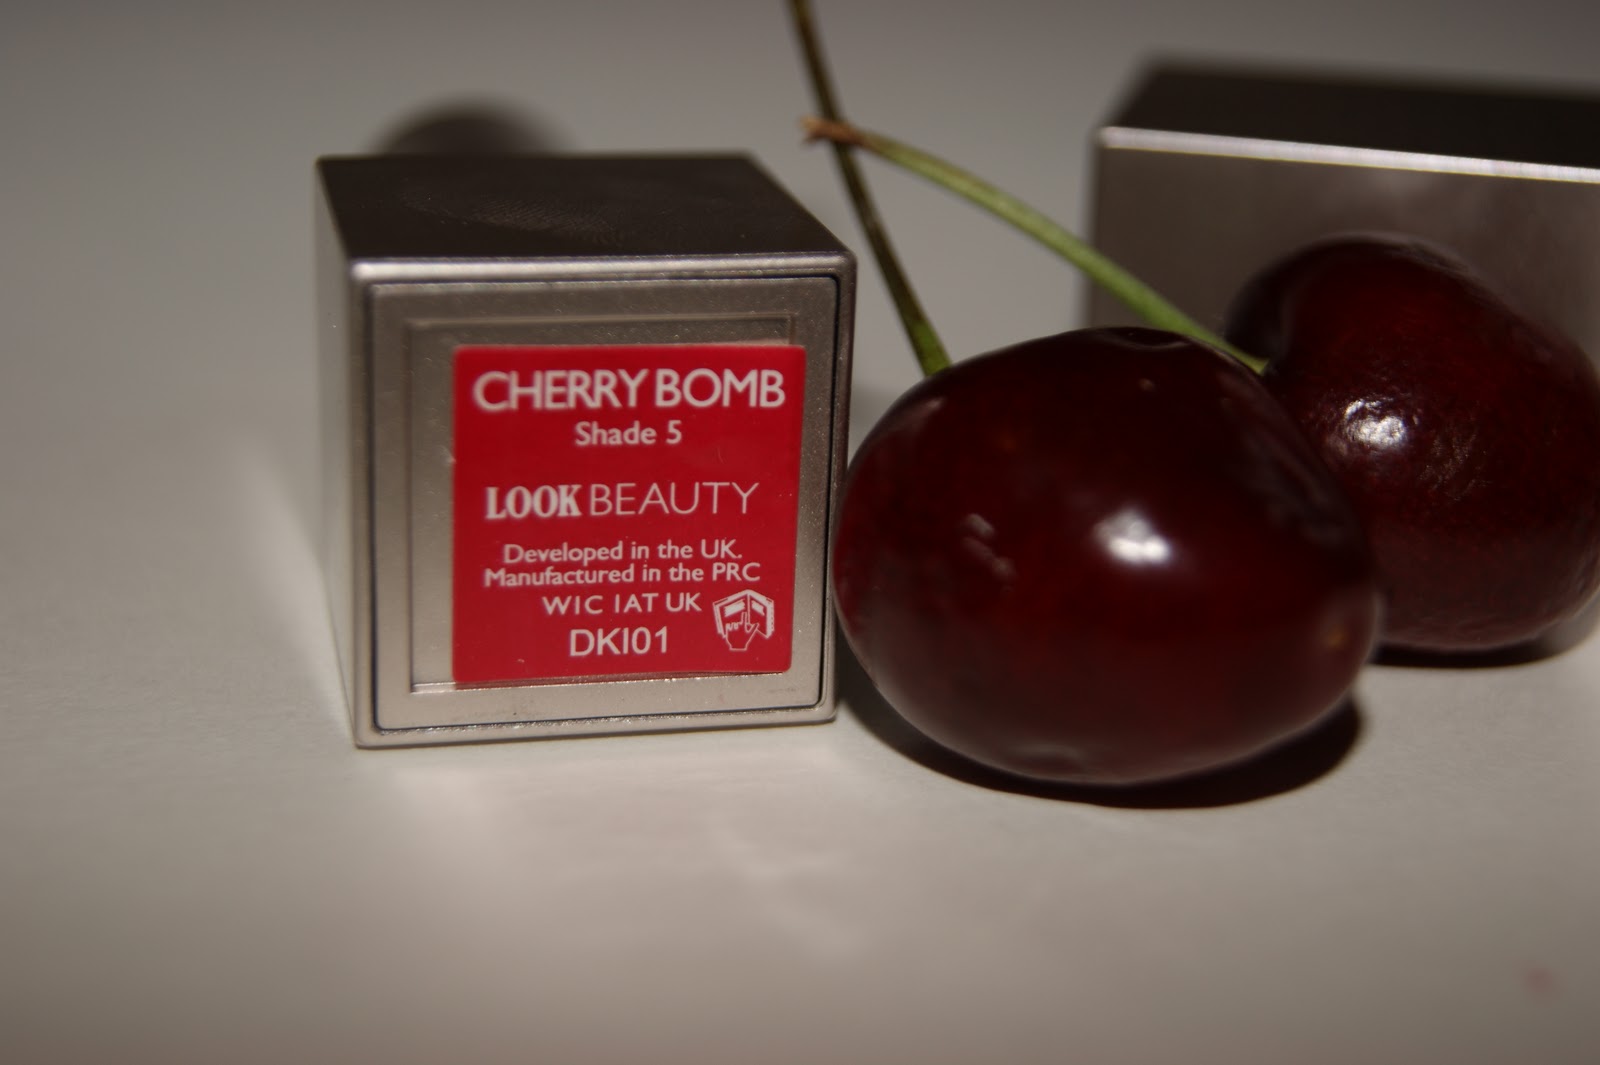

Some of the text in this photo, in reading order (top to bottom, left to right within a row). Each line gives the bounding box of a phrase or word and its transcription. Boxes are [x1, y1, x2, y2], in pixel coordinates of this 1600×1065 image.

[472, 368, 786, 411] CHERRY BOMB
[575, 420, 682, 446] Shade 5
[485, 482, 759, 519] LOOK BEAUTY
[503, 539, 742, 565] Developed in the UK.
[484, 562, 760, 587] Manufactured in the PRC
[665, 593, 701, 612] UK
